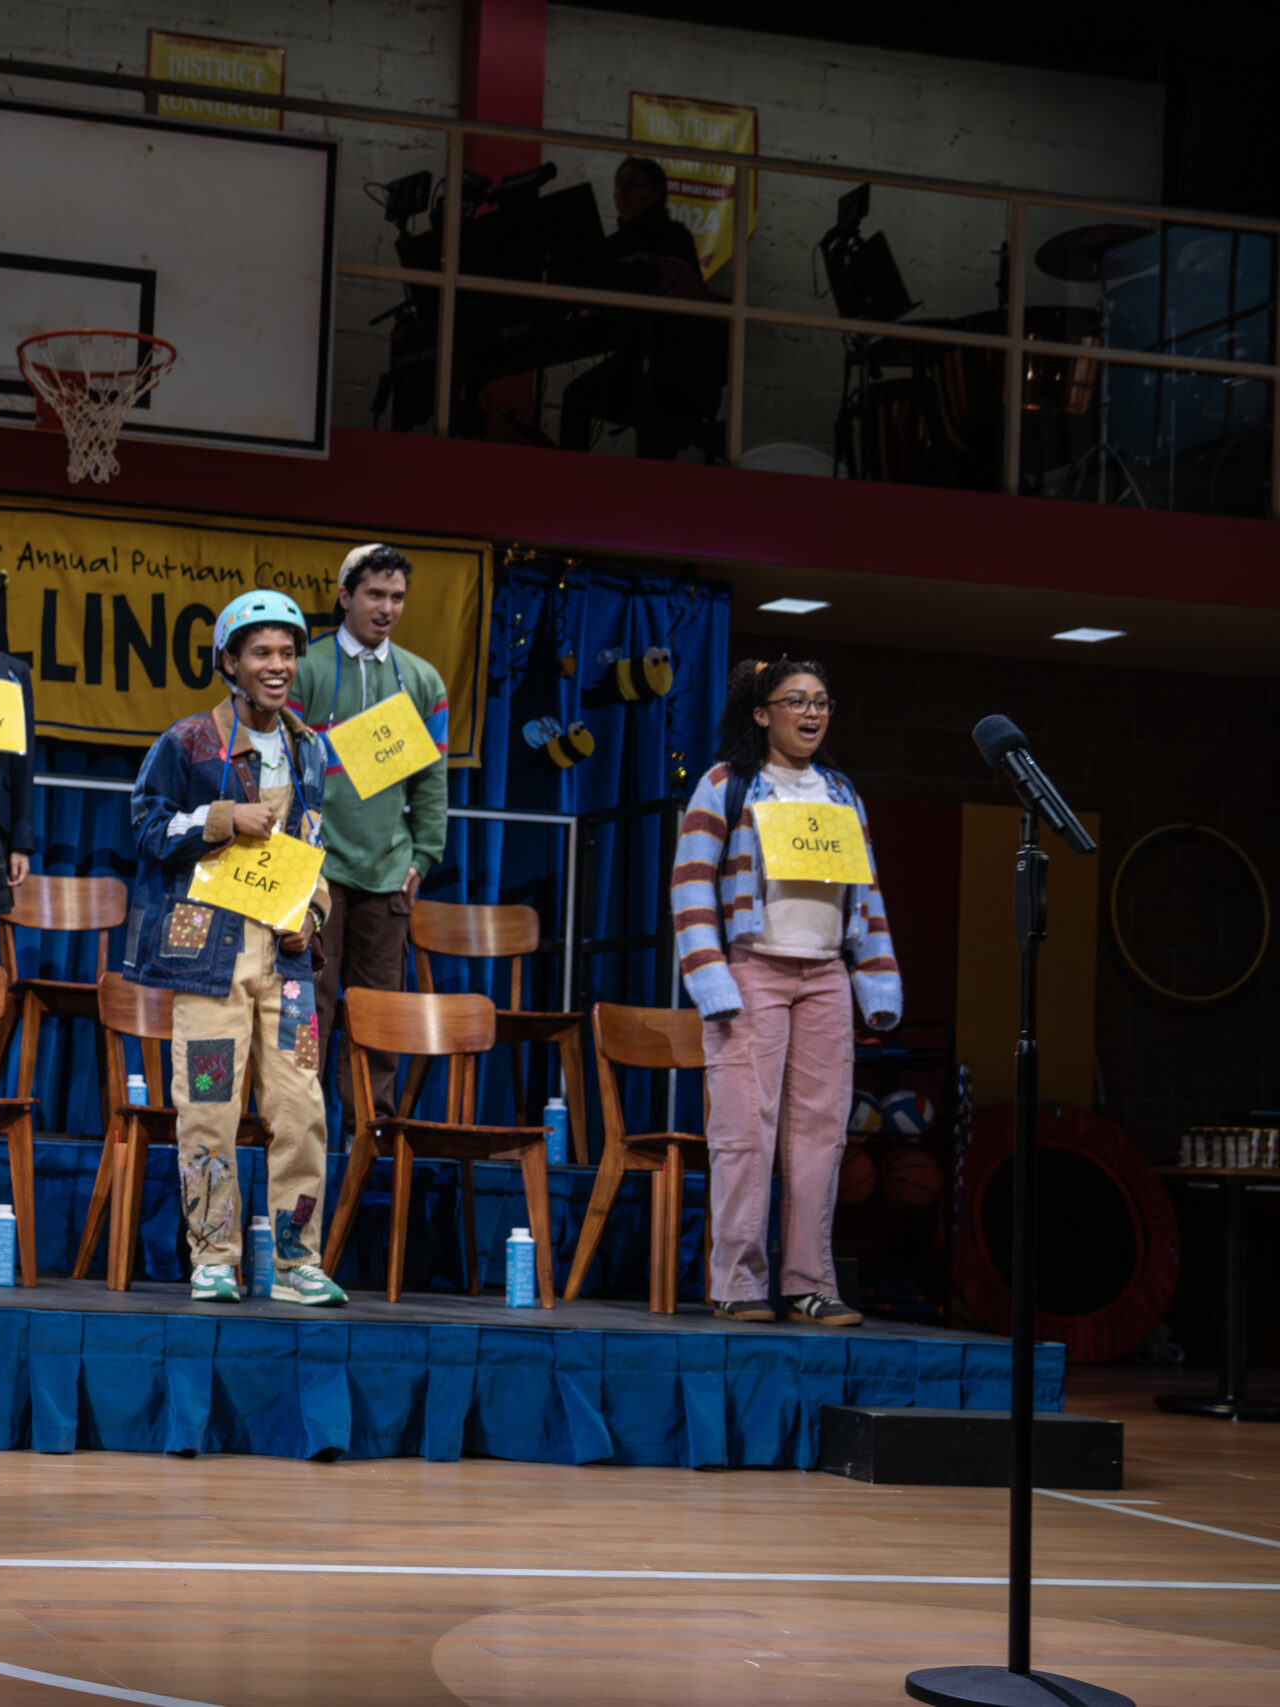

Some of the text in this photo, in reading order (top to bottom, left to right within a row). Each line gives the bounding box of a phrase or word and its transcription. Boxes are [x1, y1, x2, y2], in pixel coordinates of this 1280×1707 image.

[169, 55, 264, 89] DISTRICT
[649, 114, 737, 148] DISTRICT
[17, 542, 118, 572] Annual
[132, 550, 244, 585] Putnam
[255, 562, 338, 593] Count
[372, 724, 392, 743] 19
[374, 739, 406, 764] CHIP
[808, 817, 819, 832] 3
[792, 837, 842, 853] OLIVE
[257, 851, 271, 868] 2
[233, 867, 280, 893] LEAF
